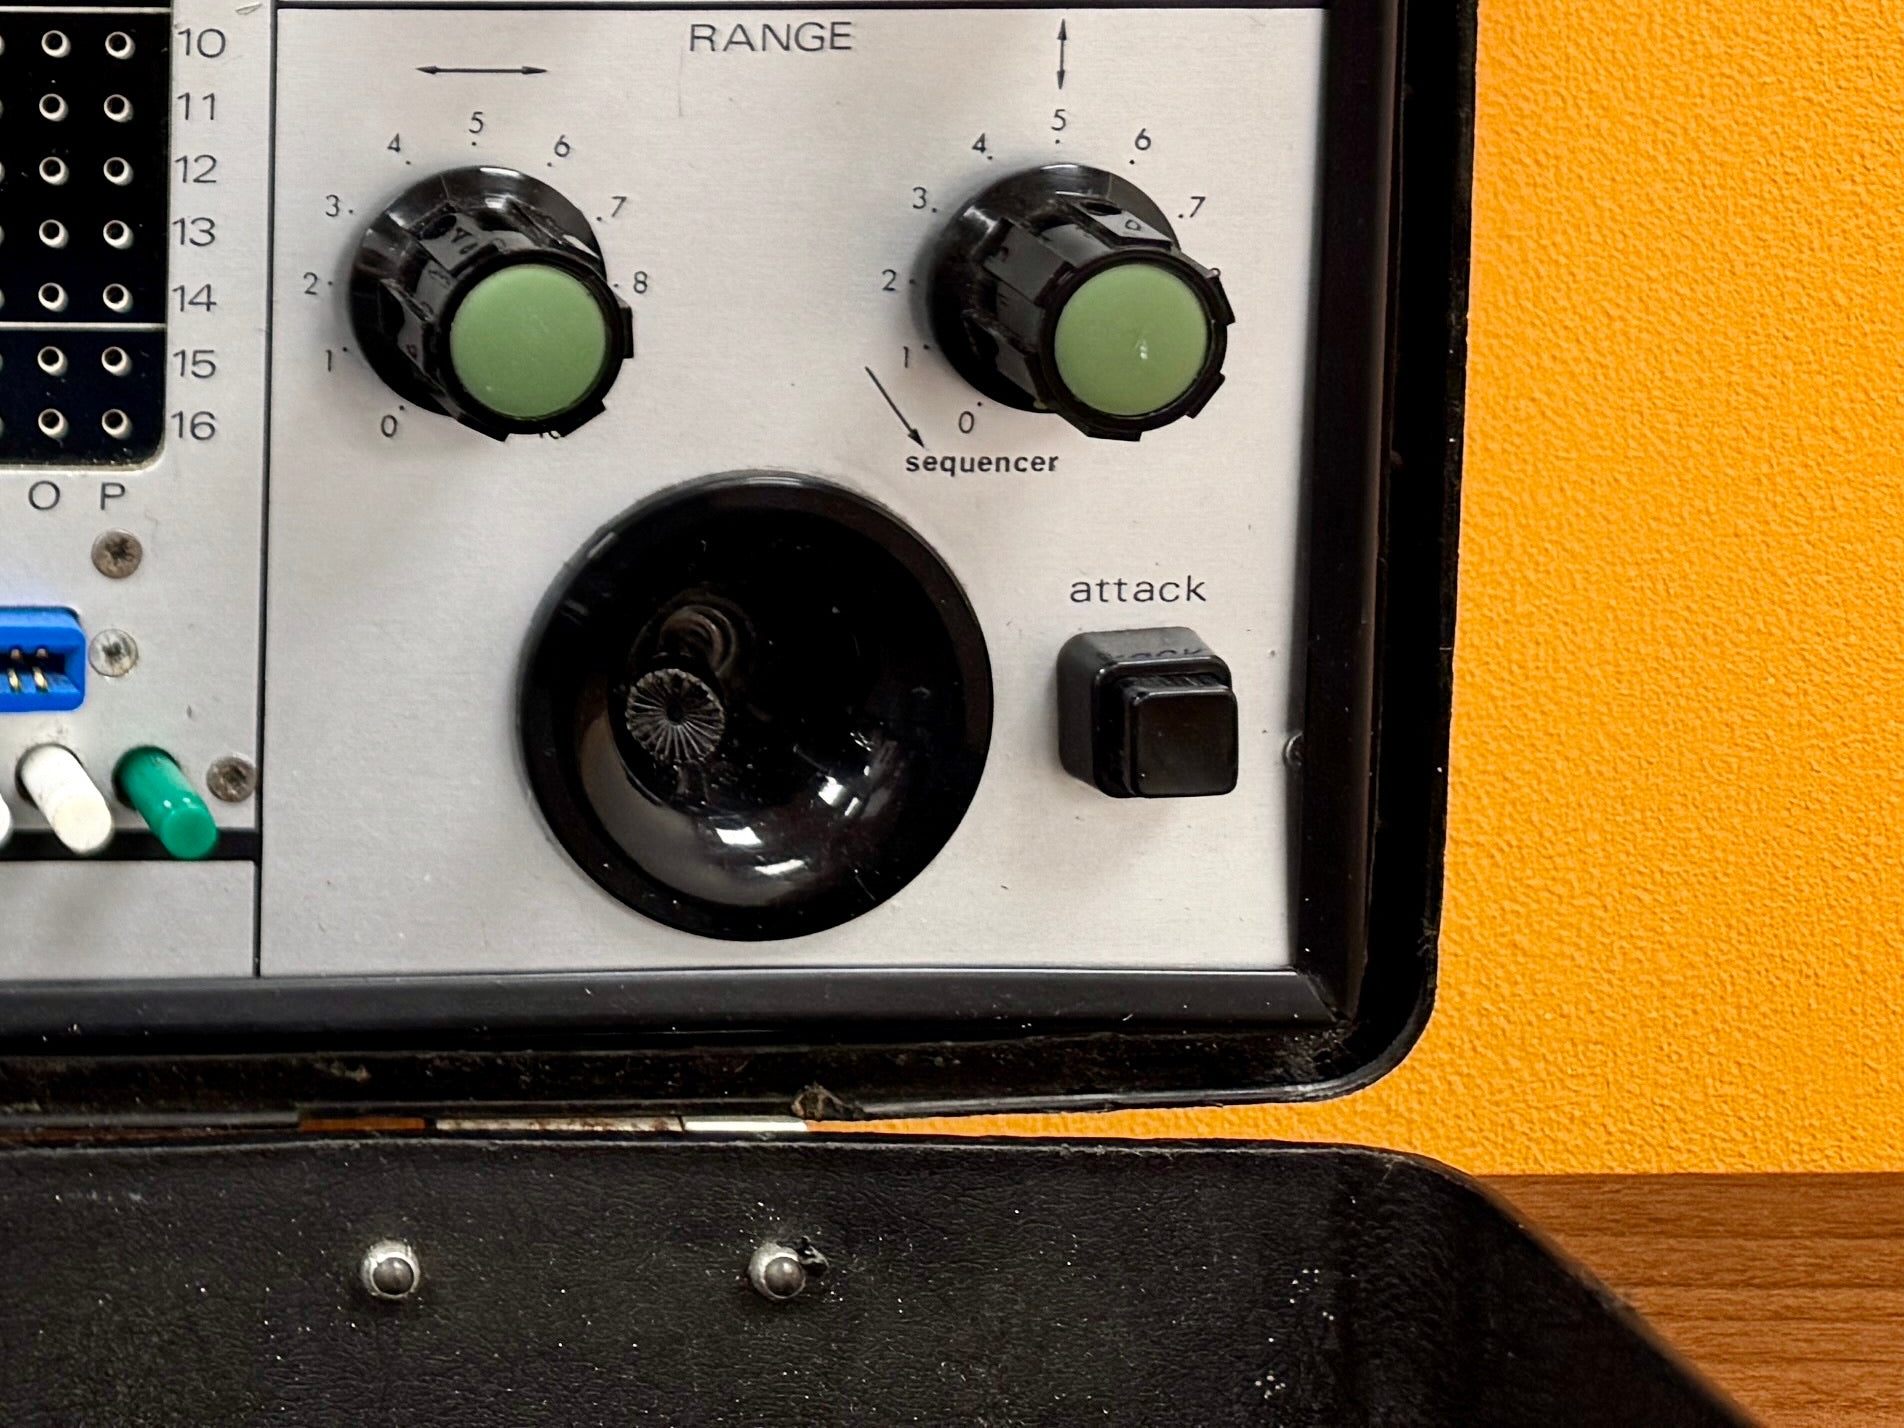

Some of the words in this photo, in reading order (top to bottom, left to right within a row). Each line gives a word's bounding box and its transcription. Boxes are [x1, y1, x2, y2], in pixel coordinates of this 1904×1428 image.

[689, 21, 853, 53] RANGE
[174, 154, 218, 184] 12
[170, 410, 216, 442] 16
[905, 455, 1059, 478] sequencer
[1069, 574, 1207, 604] attack
